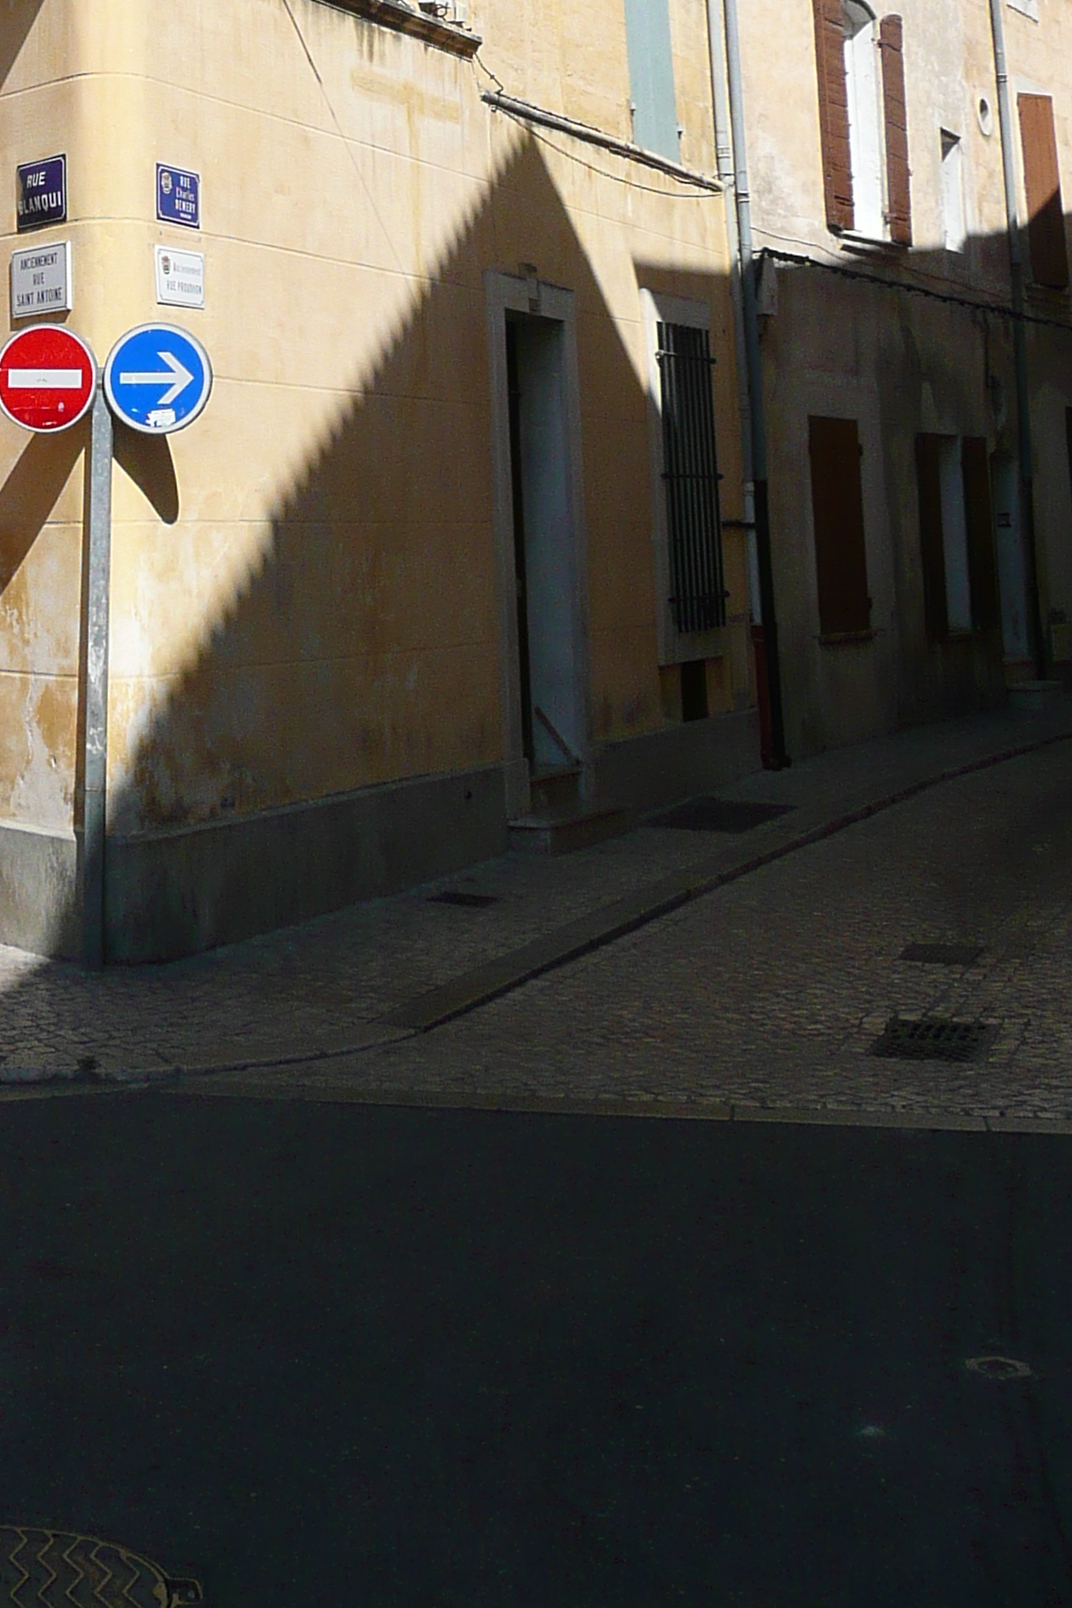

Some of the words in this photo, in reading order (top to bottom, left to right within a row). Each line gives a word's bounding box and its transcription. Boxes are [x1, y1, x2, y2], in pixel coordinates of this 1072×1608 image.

[27, 172, 46, 188] RUE
[180, 176, 190, 188] RUE
[18, 191, 61, 215] BLANQUI
[20, 253, 58, 270] ANCIENNEMENT
[33, 272, 44, 285] RUE
[167, 280, 176, 291] RUE
[16, 292, 34, 306] SAINT
[37, 287, 62, 303] ANTOINE
